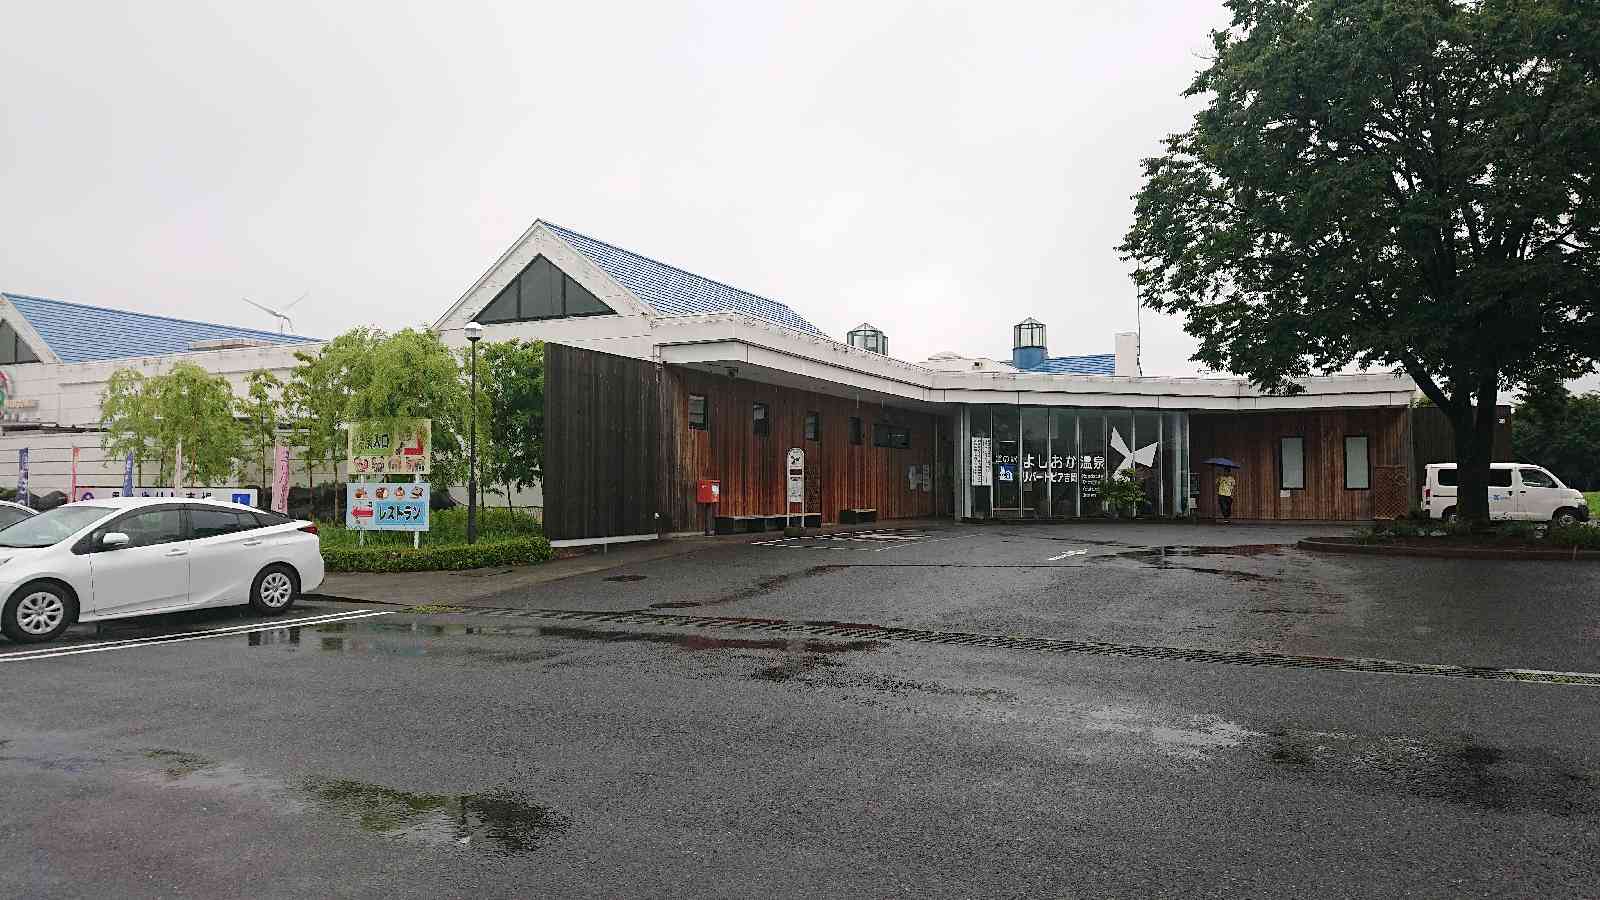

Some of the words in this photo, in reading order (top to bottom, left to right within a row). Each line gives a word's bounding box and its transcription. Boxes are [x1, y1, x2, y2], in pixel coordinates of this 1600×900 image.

[1023, 453, 1105, 470] よしおか温泉
[378, 504, 421, 521] レストラン
